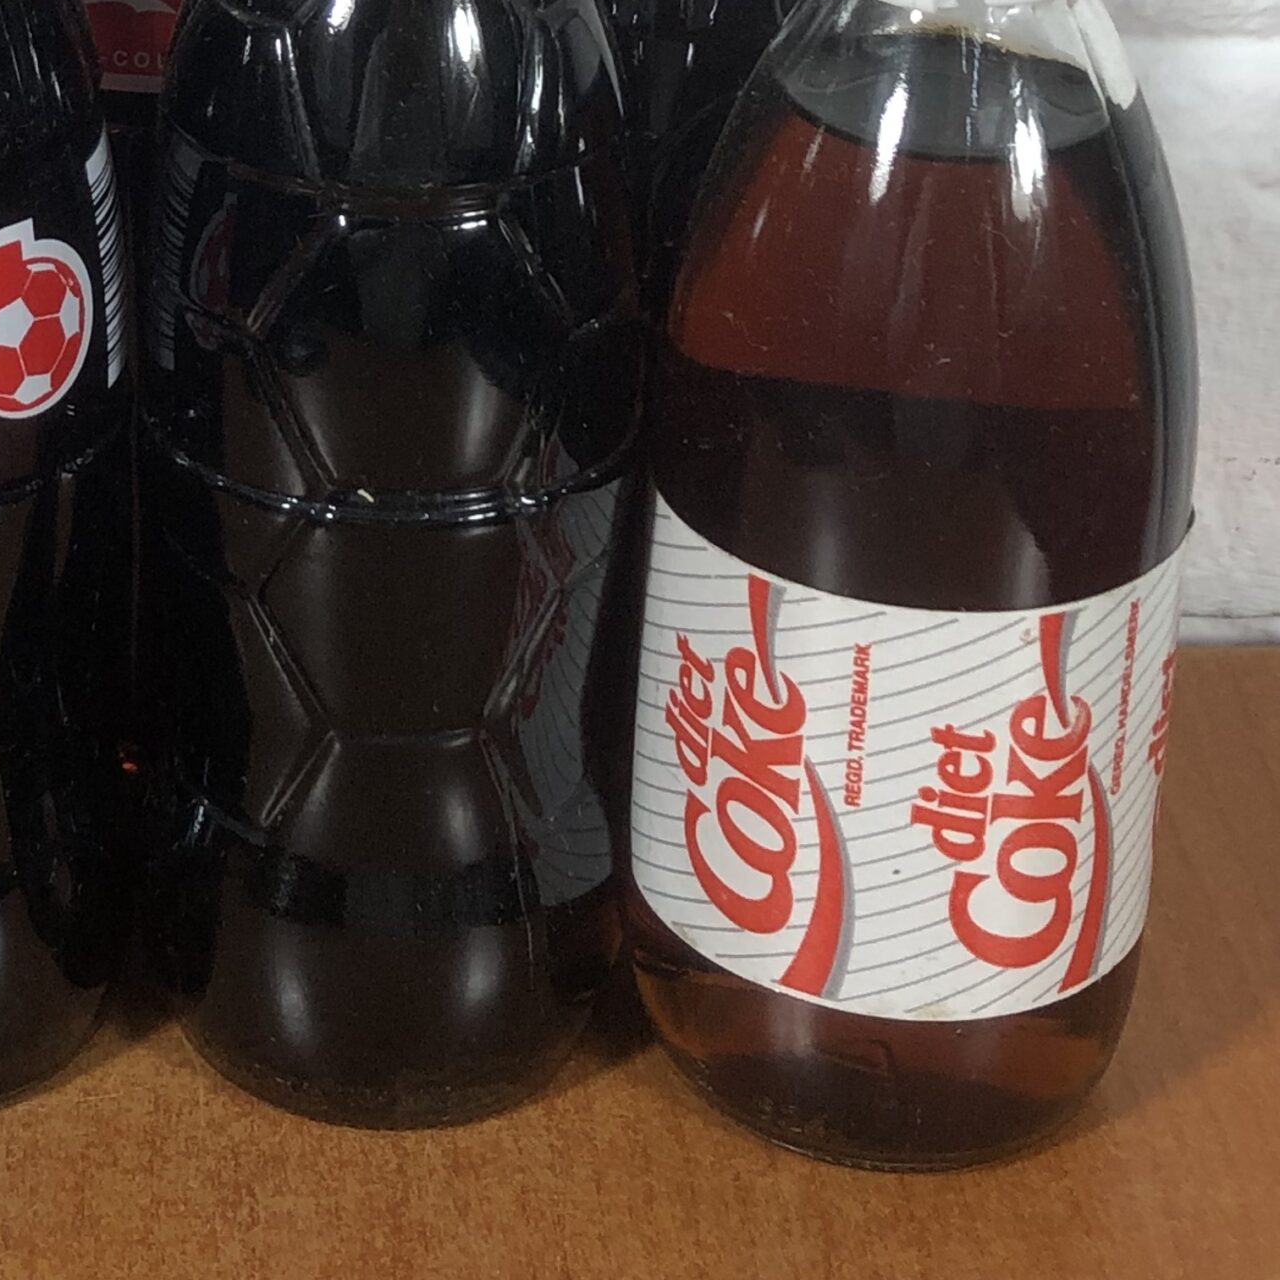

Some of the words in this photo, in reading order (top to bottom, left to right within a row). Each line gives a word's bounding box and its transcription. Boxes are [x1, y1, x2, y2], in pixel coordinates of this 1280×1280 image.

[665, 632, 717, 787] diet
[843, 756, 864, 809] REGD.
[684, 646, 808, 935] Coke
[910, 724, 997, 862] diet
[948, 693, 1093, 969] Coke
